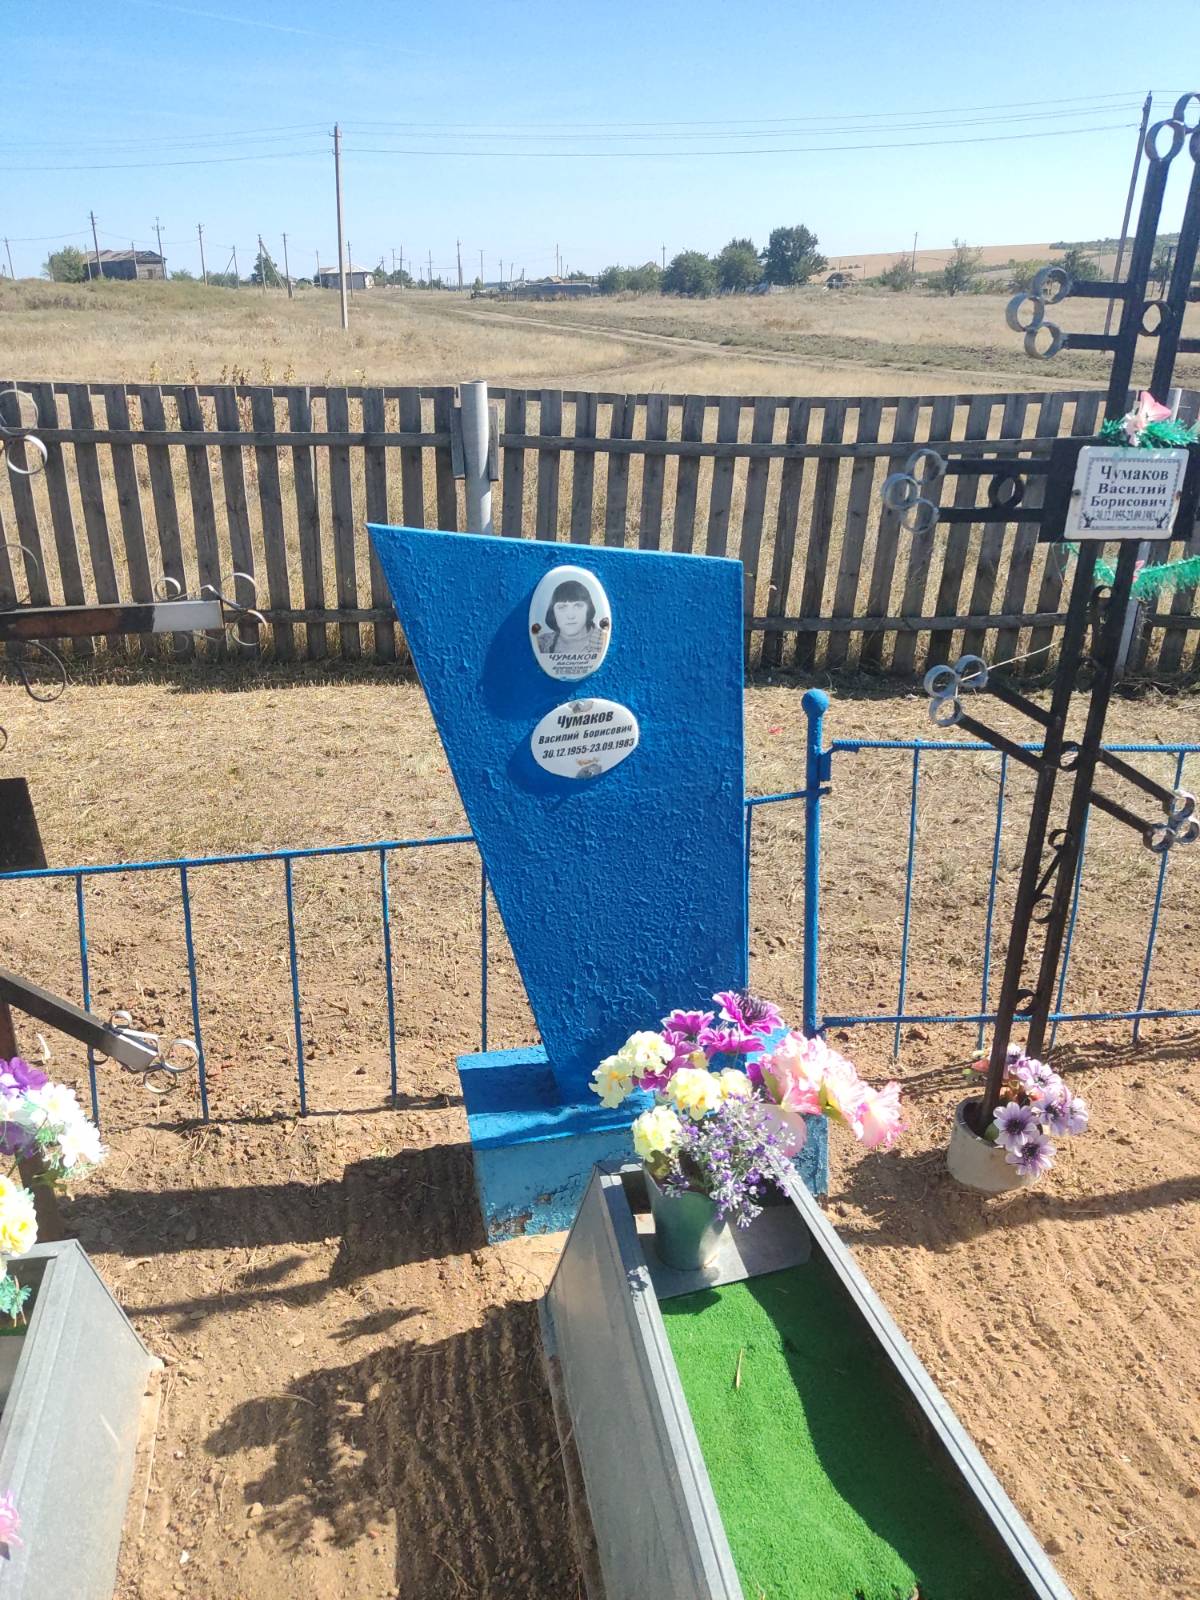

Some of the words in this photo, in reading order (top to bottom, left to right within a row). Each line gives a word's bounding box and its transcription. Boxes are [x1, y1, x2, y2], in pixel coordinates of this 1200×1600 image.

[1100, 465, 1169, 484] Чумаков
[1098, 482, 1167, 495] Василий
[1090, 495, 1167, 509] Борисович
[548, 653, 598, 661] ЧУМАКОВ
[557, 711, 614, 729] Чумаков
[538, 730, 580, 745] Василий
[583, 725, 633, 740] Борисович
